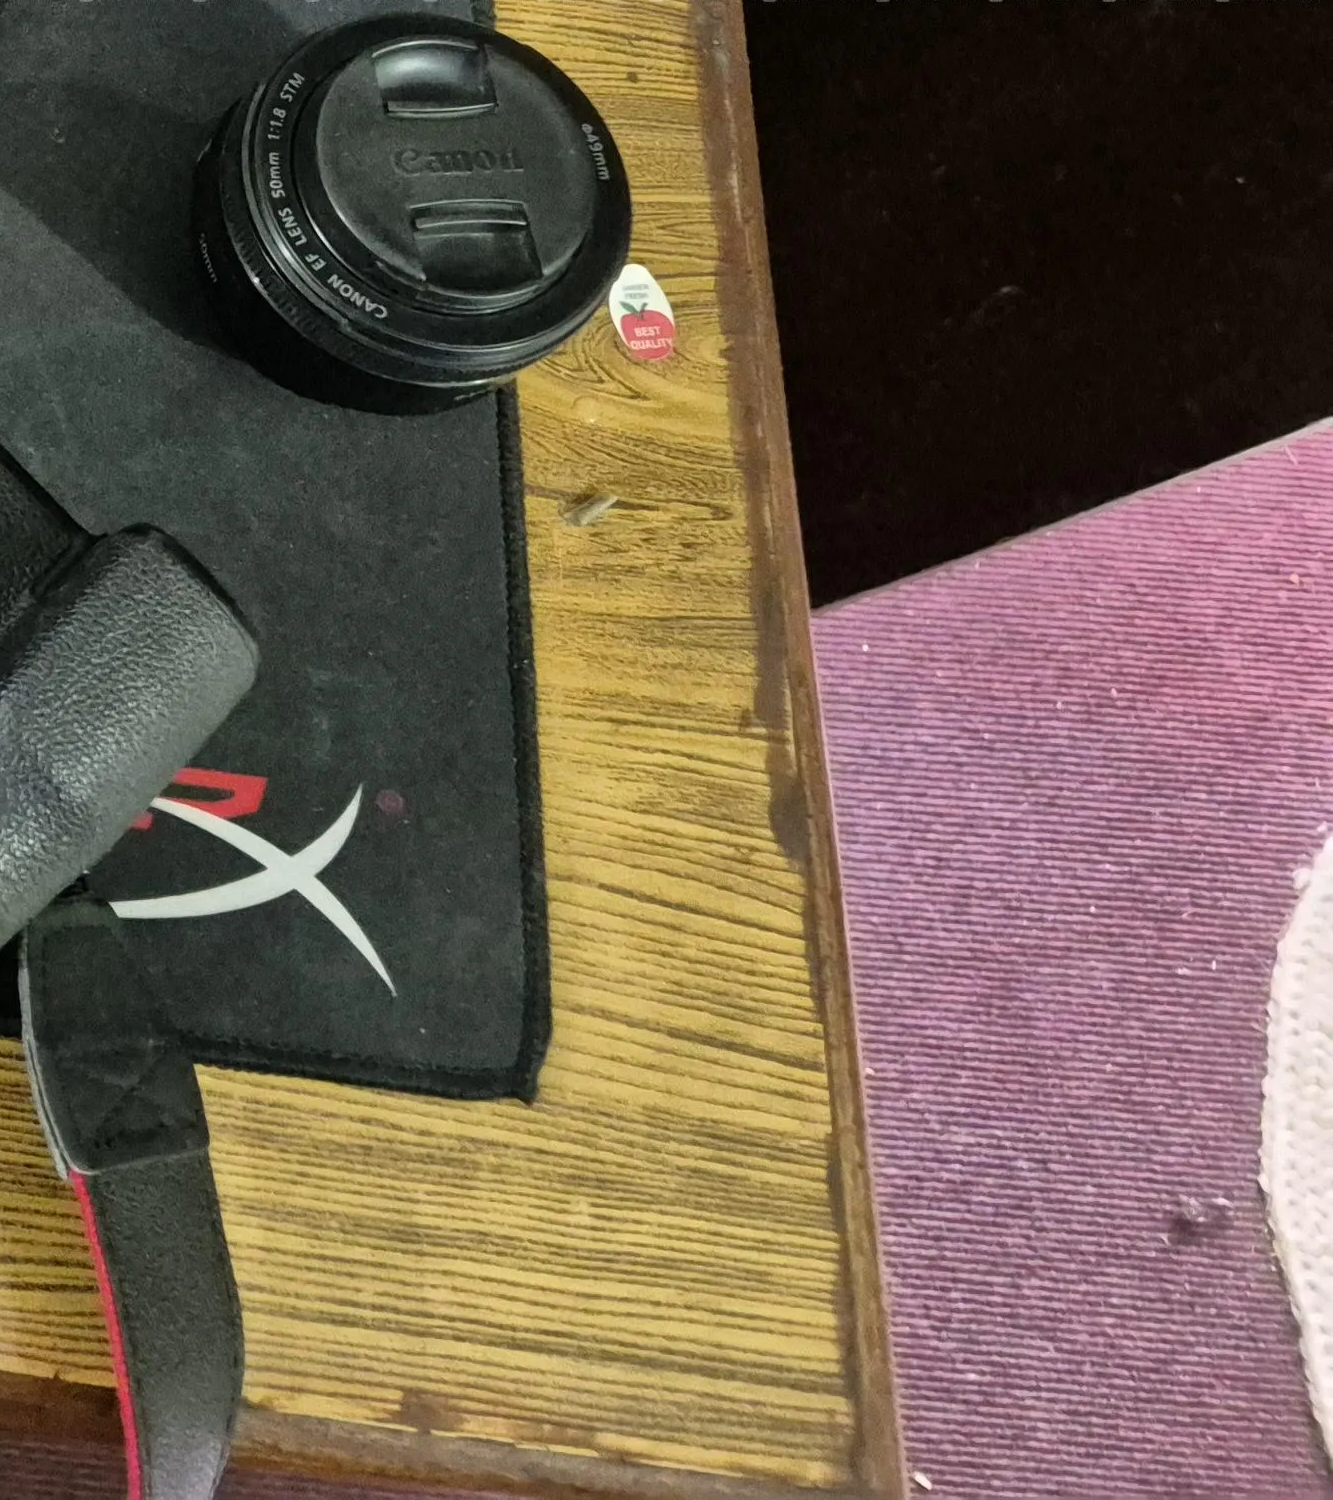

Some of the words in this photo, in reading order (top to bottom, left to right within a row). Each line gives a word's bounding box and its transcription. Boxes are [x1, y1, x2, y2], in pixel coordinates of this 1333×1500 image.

[279, 71, 305, 104] STM
[269, 151, 286, 201] 50mm
[392, 147, 525, 177] Canon
[277, 207, 310, 249] LENS
[309, 252, 327, 273] EF
[327, 272, 389, 321] CANON
[630, 337, 672, 350] QUALITY
[633, 326, 661, 337] BEST
